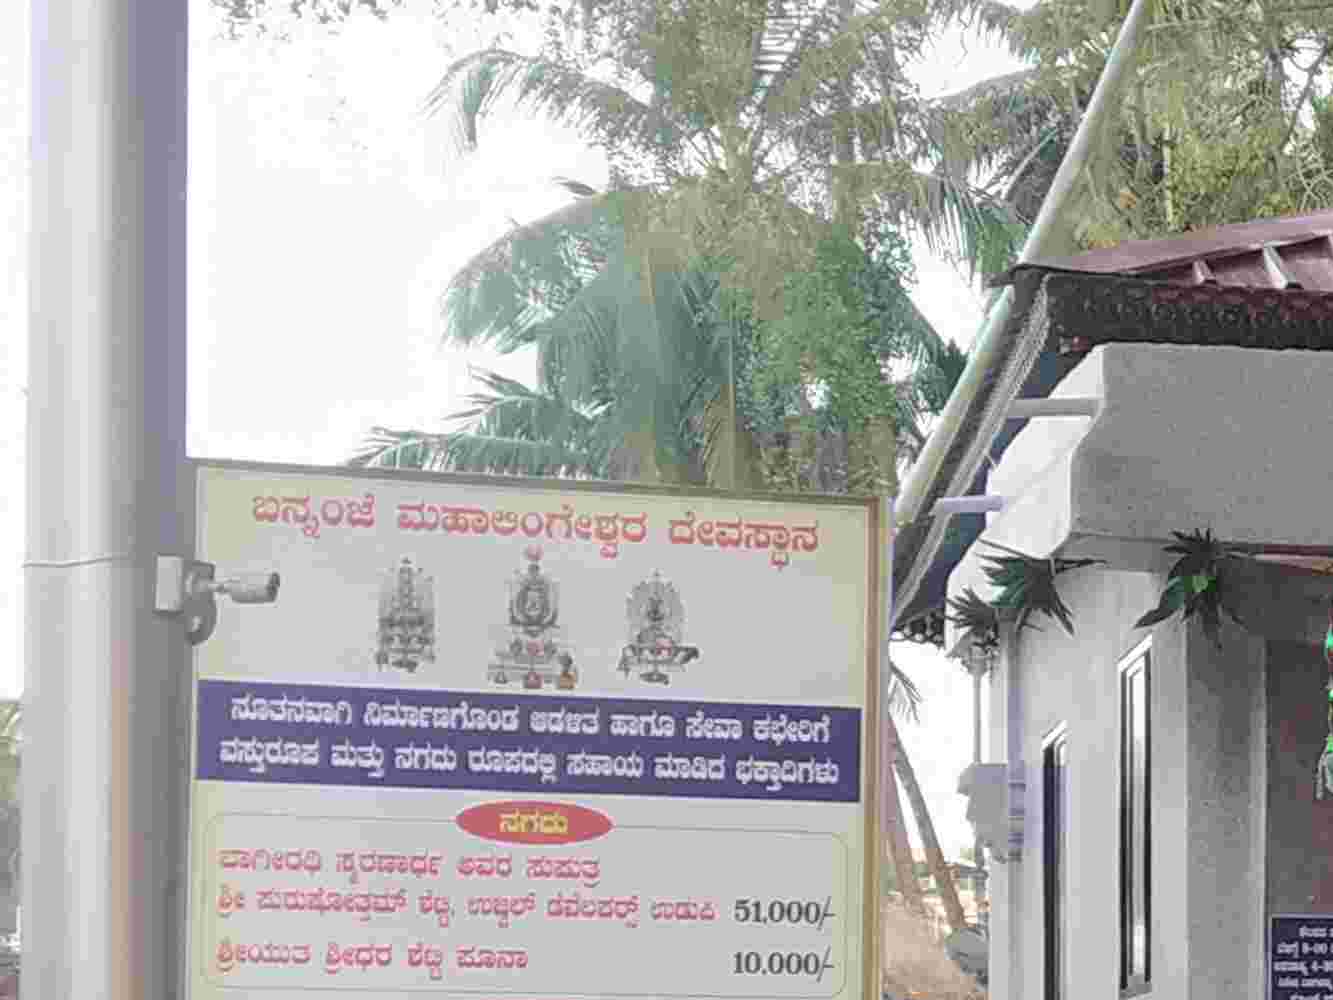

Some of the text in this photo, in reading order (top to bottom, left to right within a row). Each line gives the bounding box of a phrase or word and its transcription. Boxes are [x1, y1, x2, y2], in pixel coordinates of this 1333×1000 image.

[253, 494, 818, 567] ಬನ್ನಂಜೆ ಮಹಾಲಿಂಗೇಶ್ವರ ದೇವಸ್ಥಾನ
[610, 711, 675, 738] ಹಾಗೂ
[685, 709, 744, 740] ಸೇವಾ
[330, 739, 385, 779] ಮತ್ತು
[395, 742, 456, 771] ನಗದು
[566, 750, 645, 779] ಸಹಾಯ
[654, 753, 726, 781] ಮಾಡಿದ
[499, 808, 569, 835] ನಗದು
